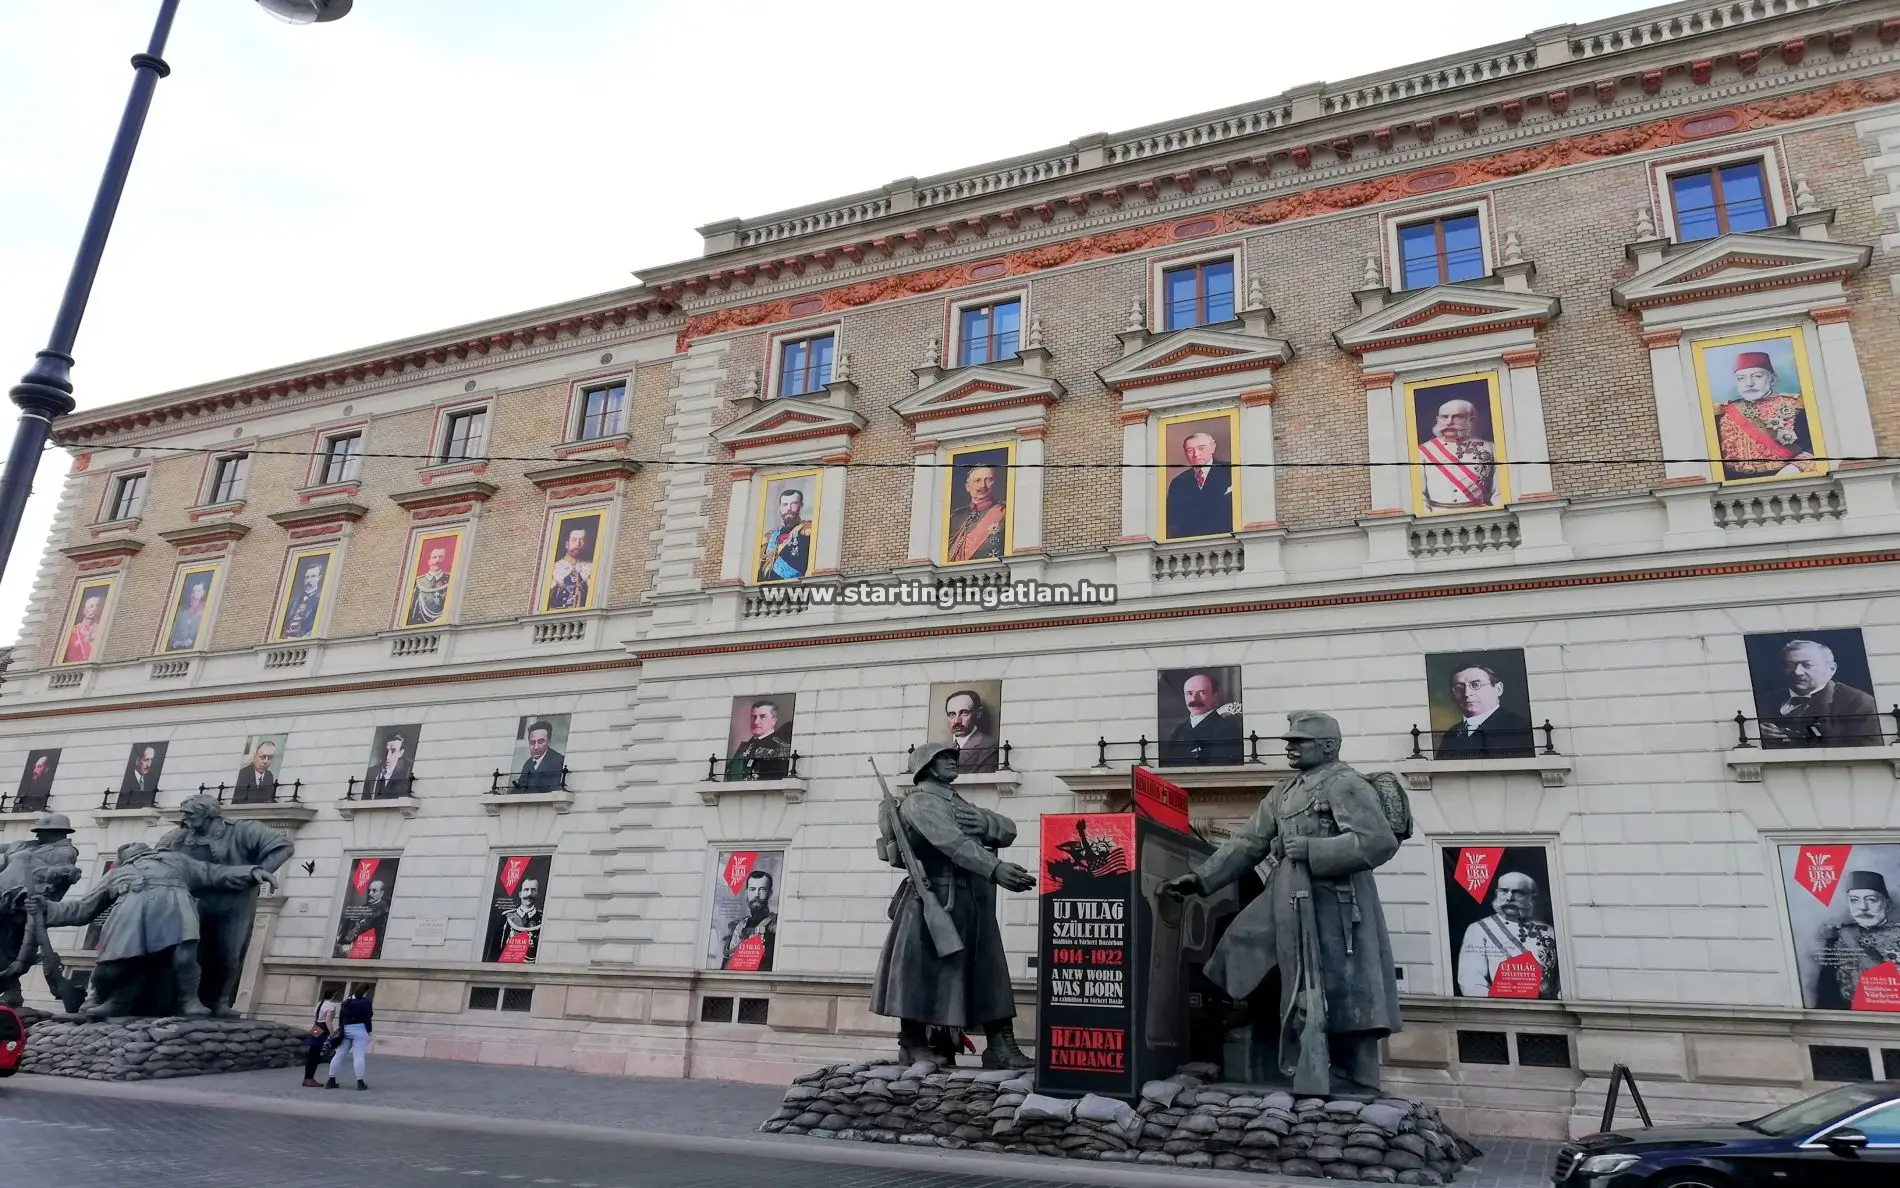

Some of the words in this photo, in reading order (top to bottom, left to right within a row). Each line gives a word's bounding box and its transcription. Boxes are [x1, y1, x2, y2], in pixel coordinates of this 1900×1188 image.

[1467, 869, 1489, 878] URAI
[1808, 870, 1836, 880] URAI
[1053, 899, 1071, 919] ÚJ
[1077, 899, 1124, 920] VILÁG
[1053, 920, 1125, 939] SZÜLETETT
[1053, 948, 1083, 964] 1914
[1091, 949, 1123, 965] 1922
[1051, 968, 1059, 980] A
[1062, 969, 1083, 980] NEW
[1086, 969, 1123, 982] WORLD
[1512, 962, 1536, 972] VILÁG
[1052, 980, 1080, 996] WAS
[1084, 981, 1123, 998] BORN
[1051, 1028, 1124, 1050] BEJÁRAT
[1051, 1048, 1124, 1069] ENTRANCE
